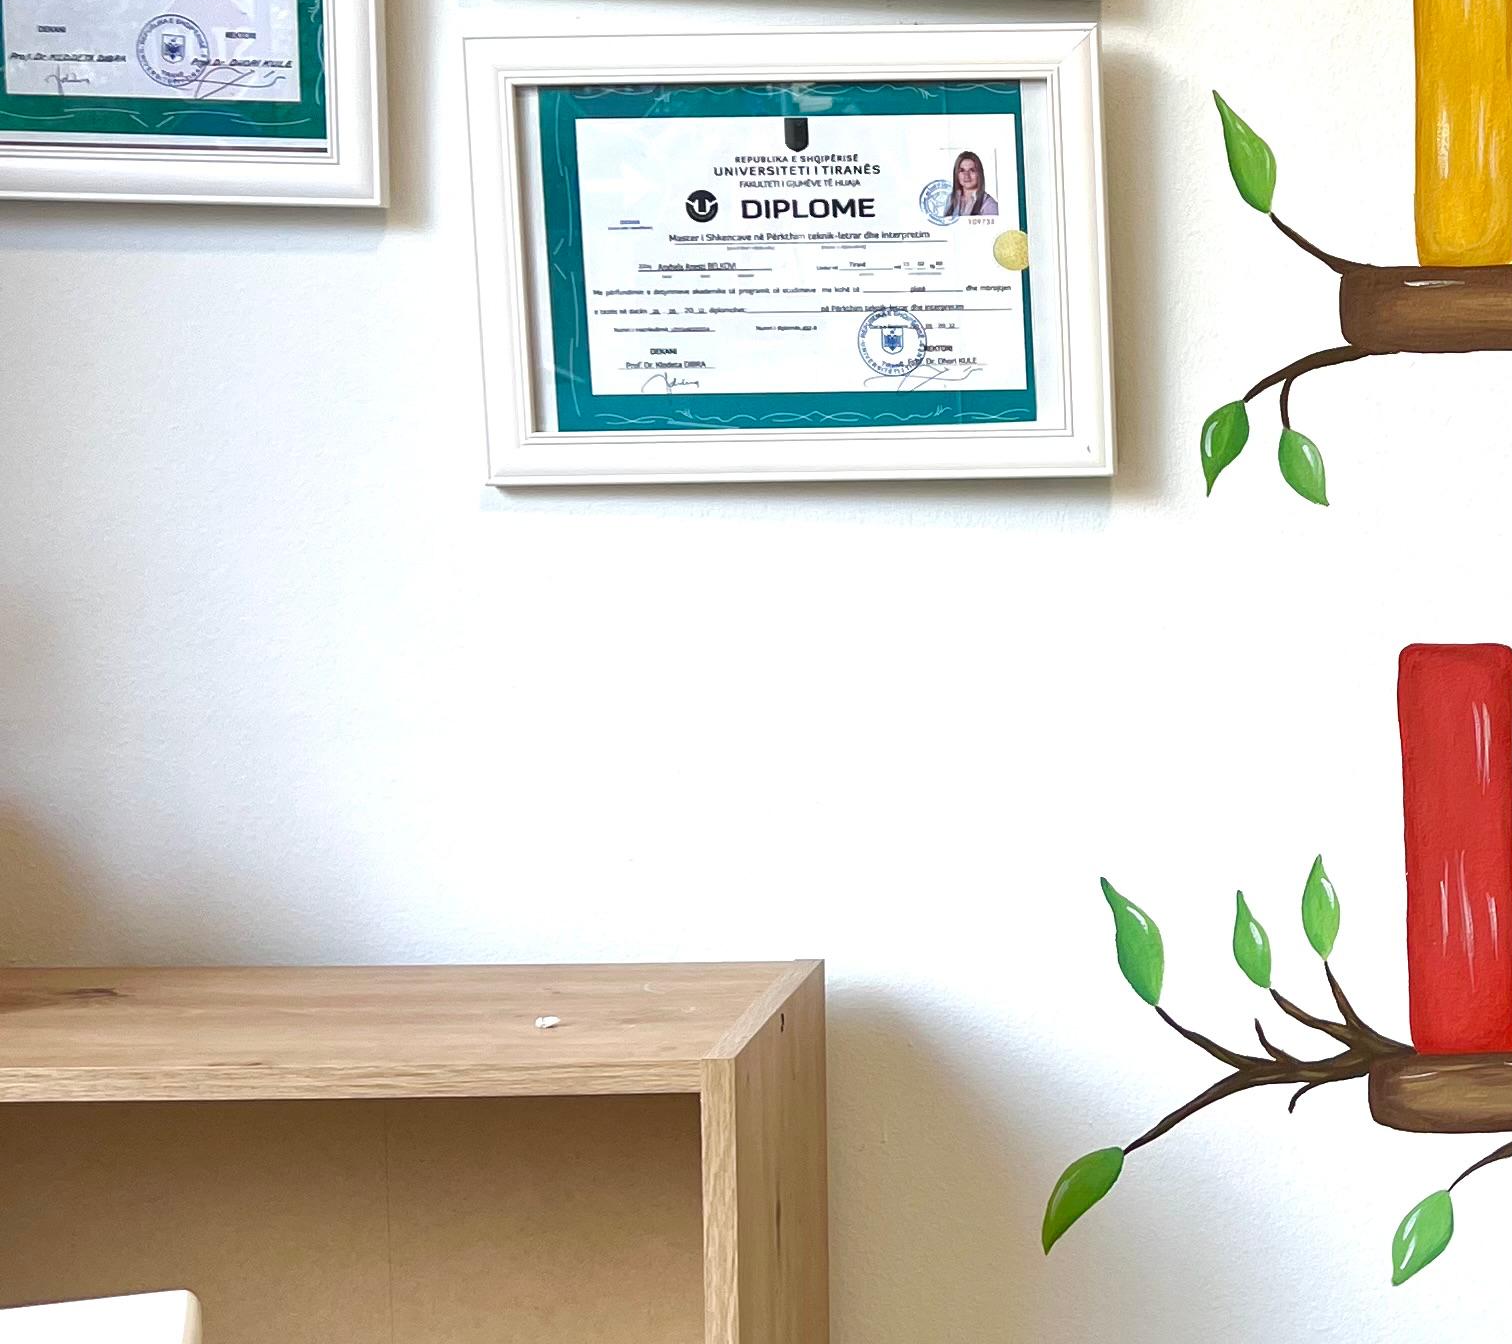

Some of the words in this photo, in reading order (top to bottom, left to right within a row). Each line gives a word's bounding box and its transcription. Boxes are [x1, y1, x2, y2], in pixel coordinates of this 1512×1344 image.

[735, 156, 789, 164] REPUBLIKA
[800, 153, 859, 164] SHQIPËRISË
[713, 166, 810, 177] UNIVERSITETI
[814, 165, 818, 175] I
[821, 163, 881, 175] TIRANËS
[741, 198, 876, 219] DIPLOME
